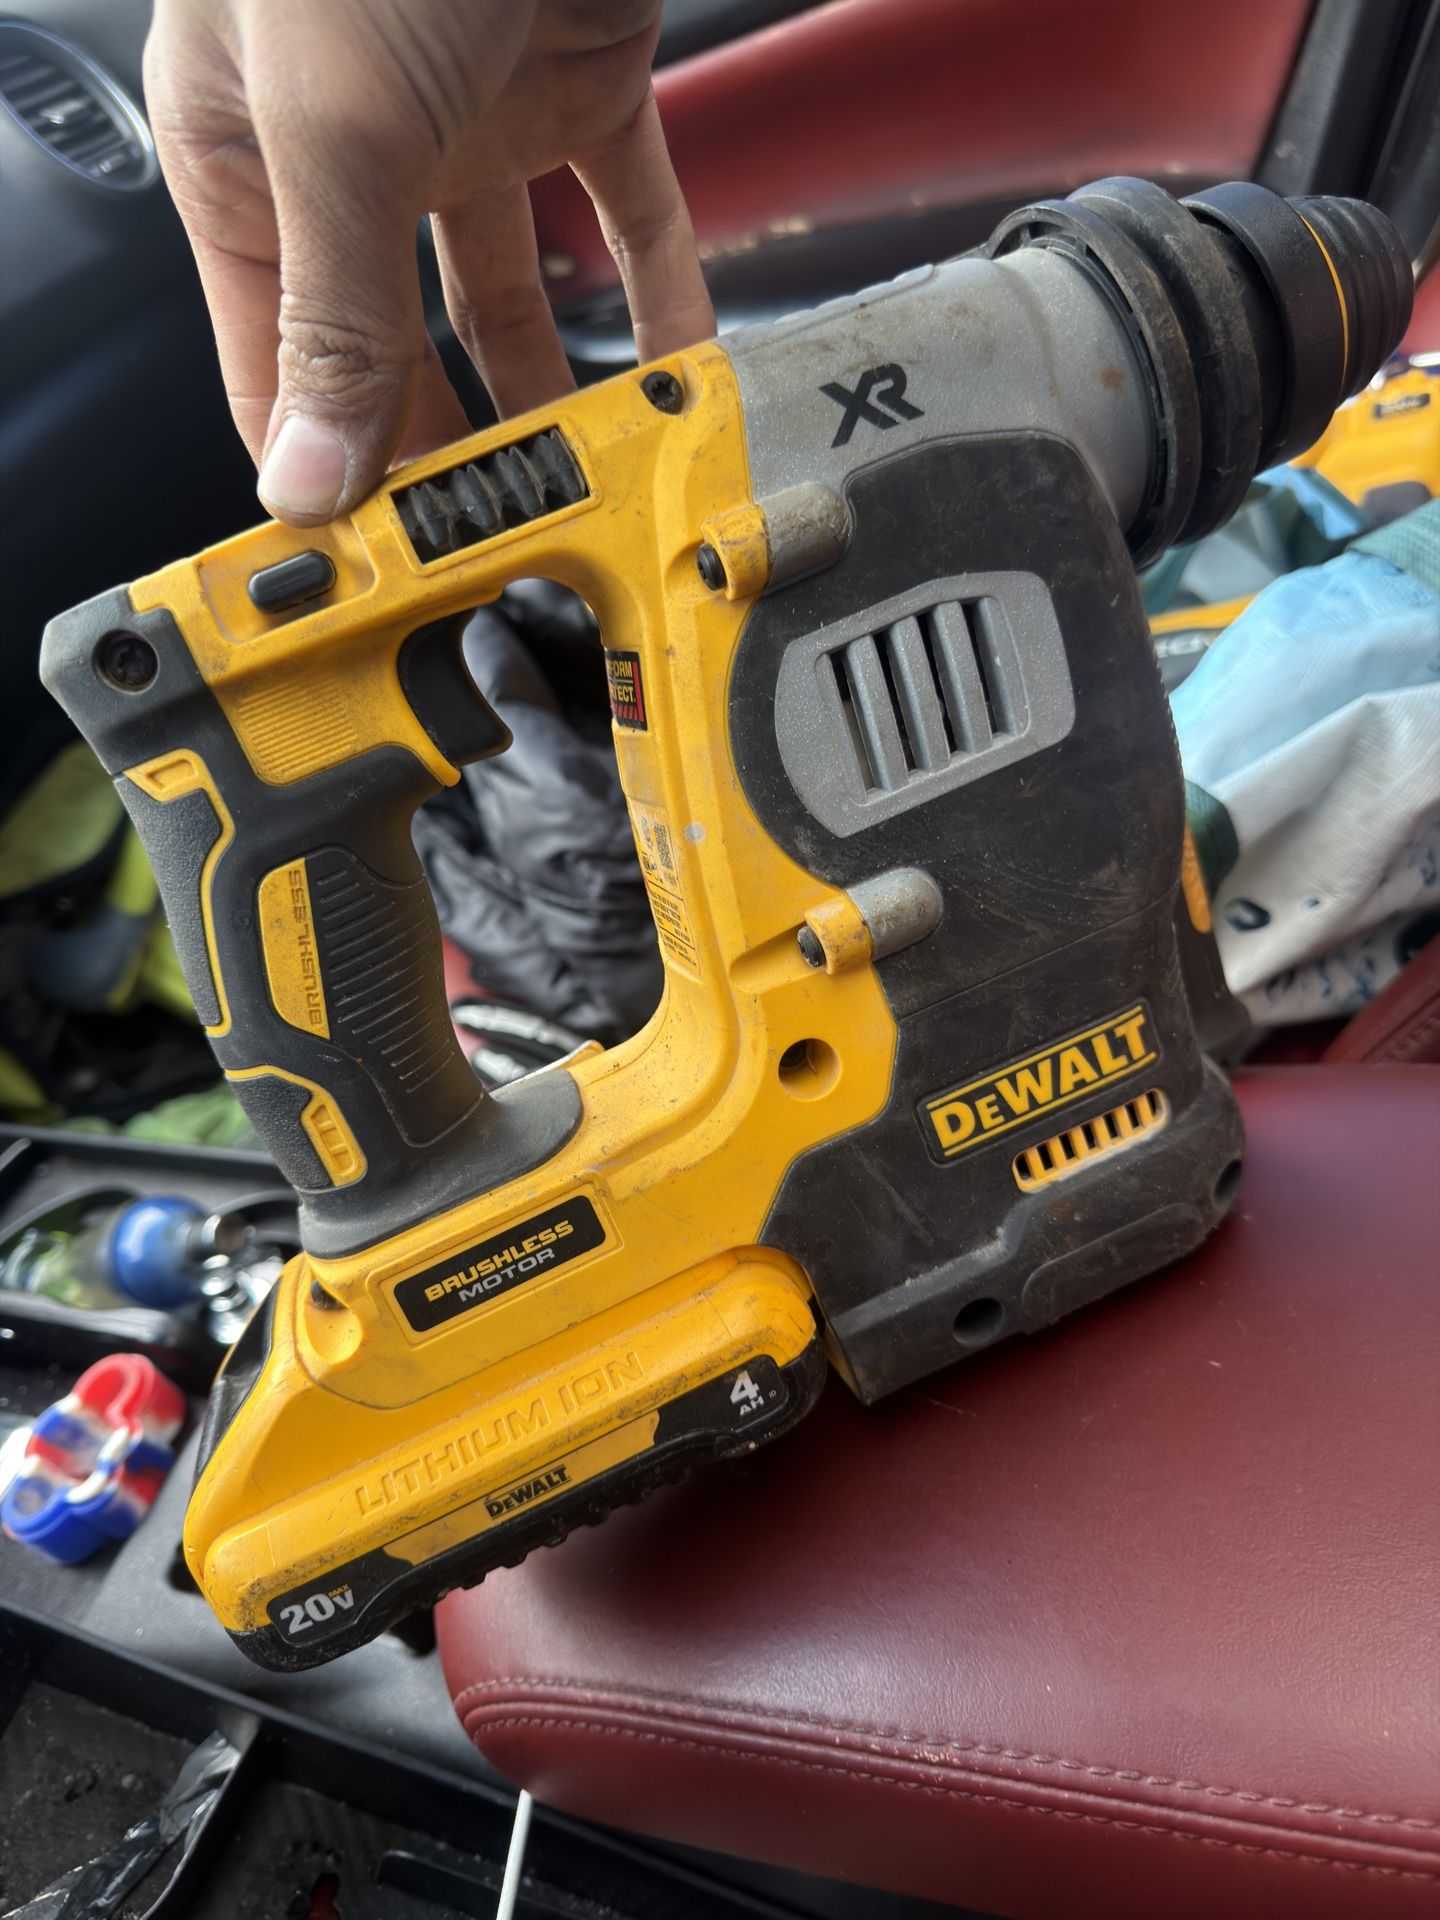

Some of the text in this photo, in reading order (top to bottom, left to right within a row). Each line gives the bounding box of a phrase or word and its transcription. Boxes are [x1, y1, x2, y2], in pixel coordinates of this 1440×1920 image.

[818, 363, 925, 449] XR
[288, 869, 323, 1026] BRUSHLESS
[424, 1220, 574, 1302] BRUSHLESS
[458, 1247, 556, 1302] MOTOR
[730, 1370, 760, 1404] 4
[355, 1351, 646, 1518] LITHIUM ION
